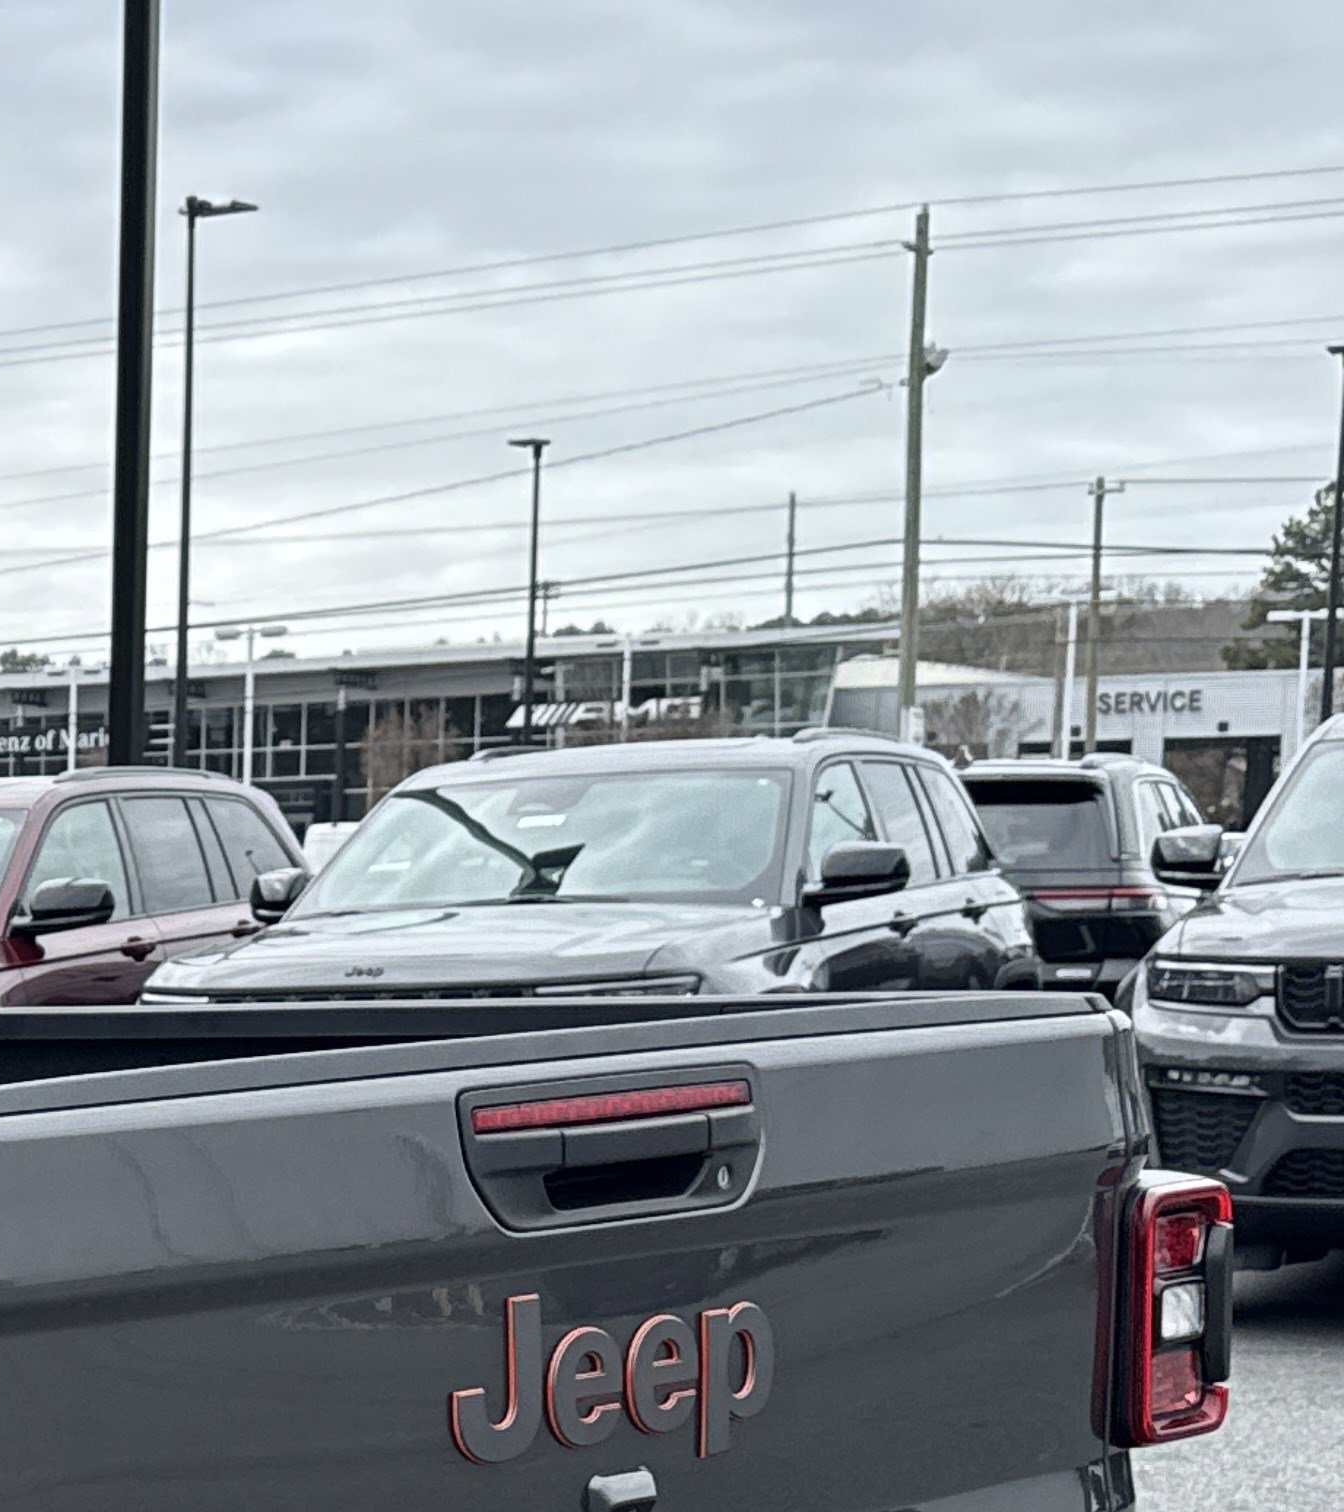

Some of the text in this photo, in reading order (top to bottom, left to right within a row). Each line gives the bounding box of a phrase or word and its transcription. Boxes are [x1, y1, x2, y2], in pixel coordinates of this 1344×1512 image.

[1098, 689, 1202, 715] SERVICE
[34, 728, 57, 750] of
[344, 965, 385, 978] Jeep
[448, 1292, 775, 1465] Jeep
